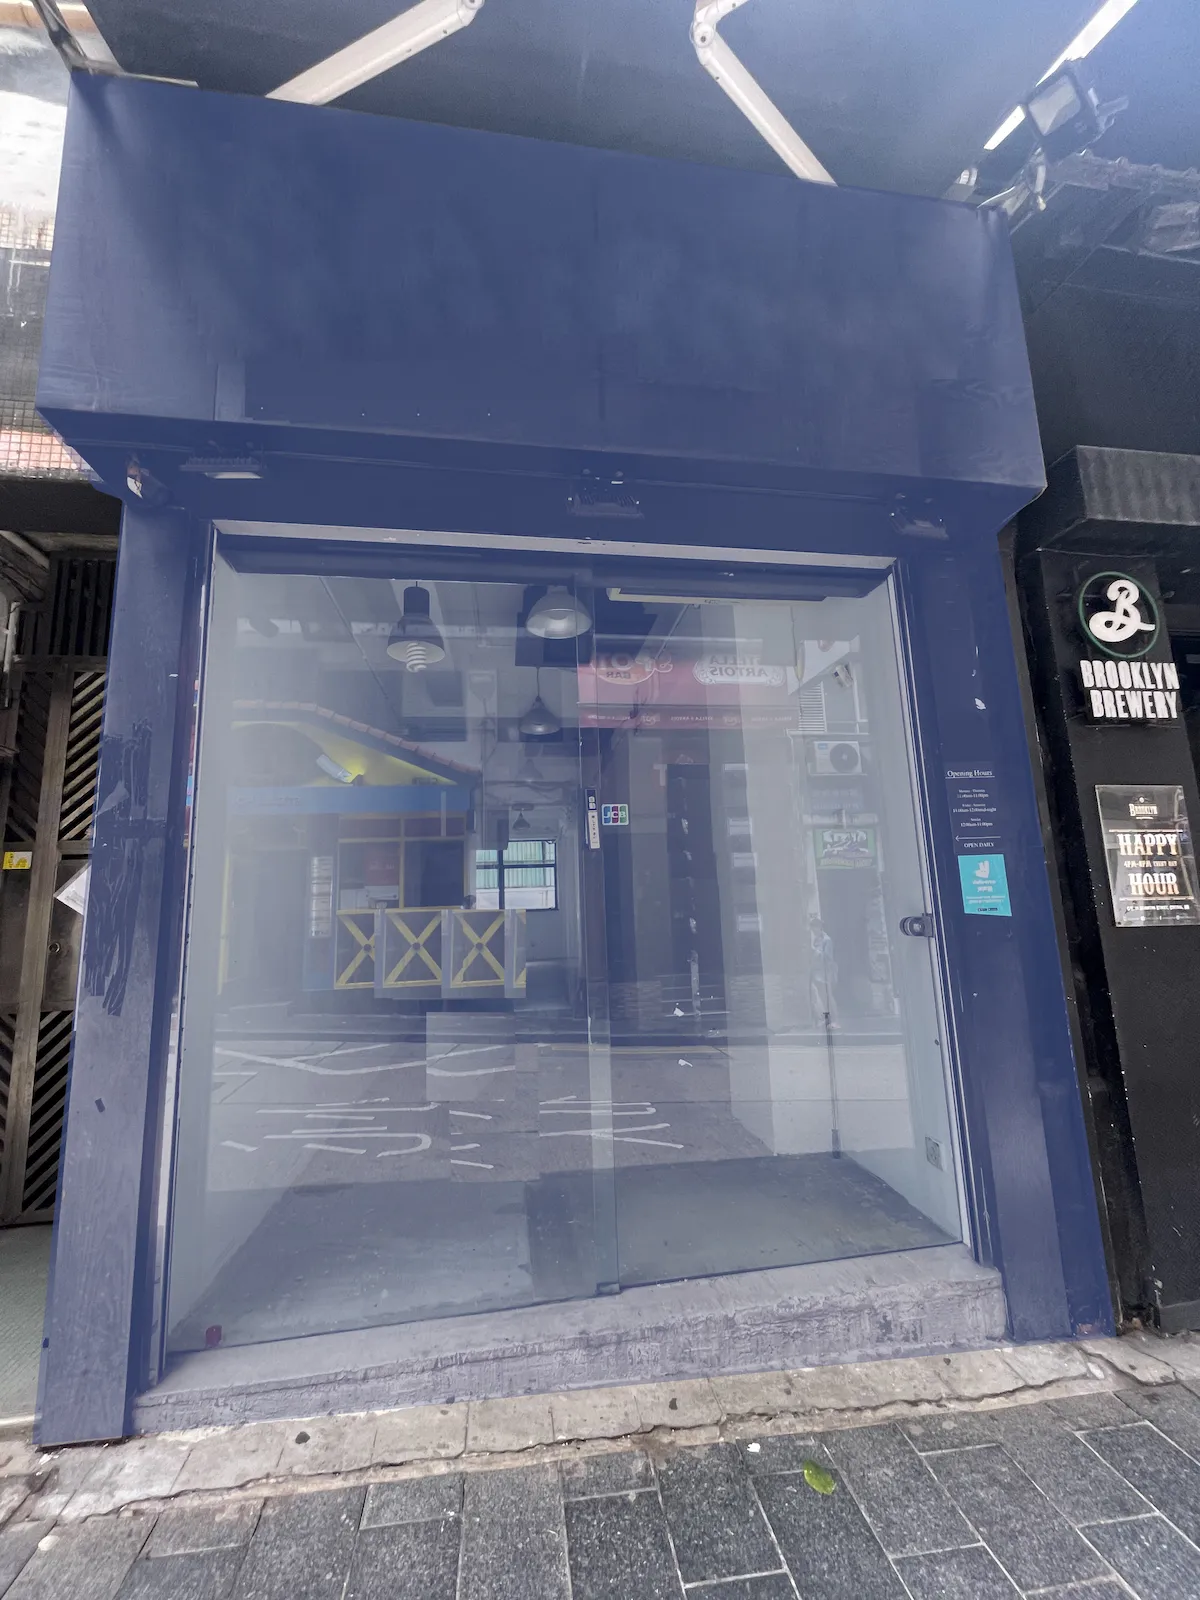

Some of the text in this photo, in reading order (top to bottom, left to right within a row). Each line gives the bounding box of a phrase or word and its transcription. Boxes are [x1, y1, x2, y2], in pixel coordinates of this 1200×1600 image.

[1079, 659, 1180, 689] BROOKLYN
[1089, 689, 1178, 719] BREWERY
[947, 769, 993, 778] Opening Hours
[603, 811, 627, 819] JCB
[1116, 833, 1178, 856] HAPPY
[1128, 872, 1180, 896] HOUR
